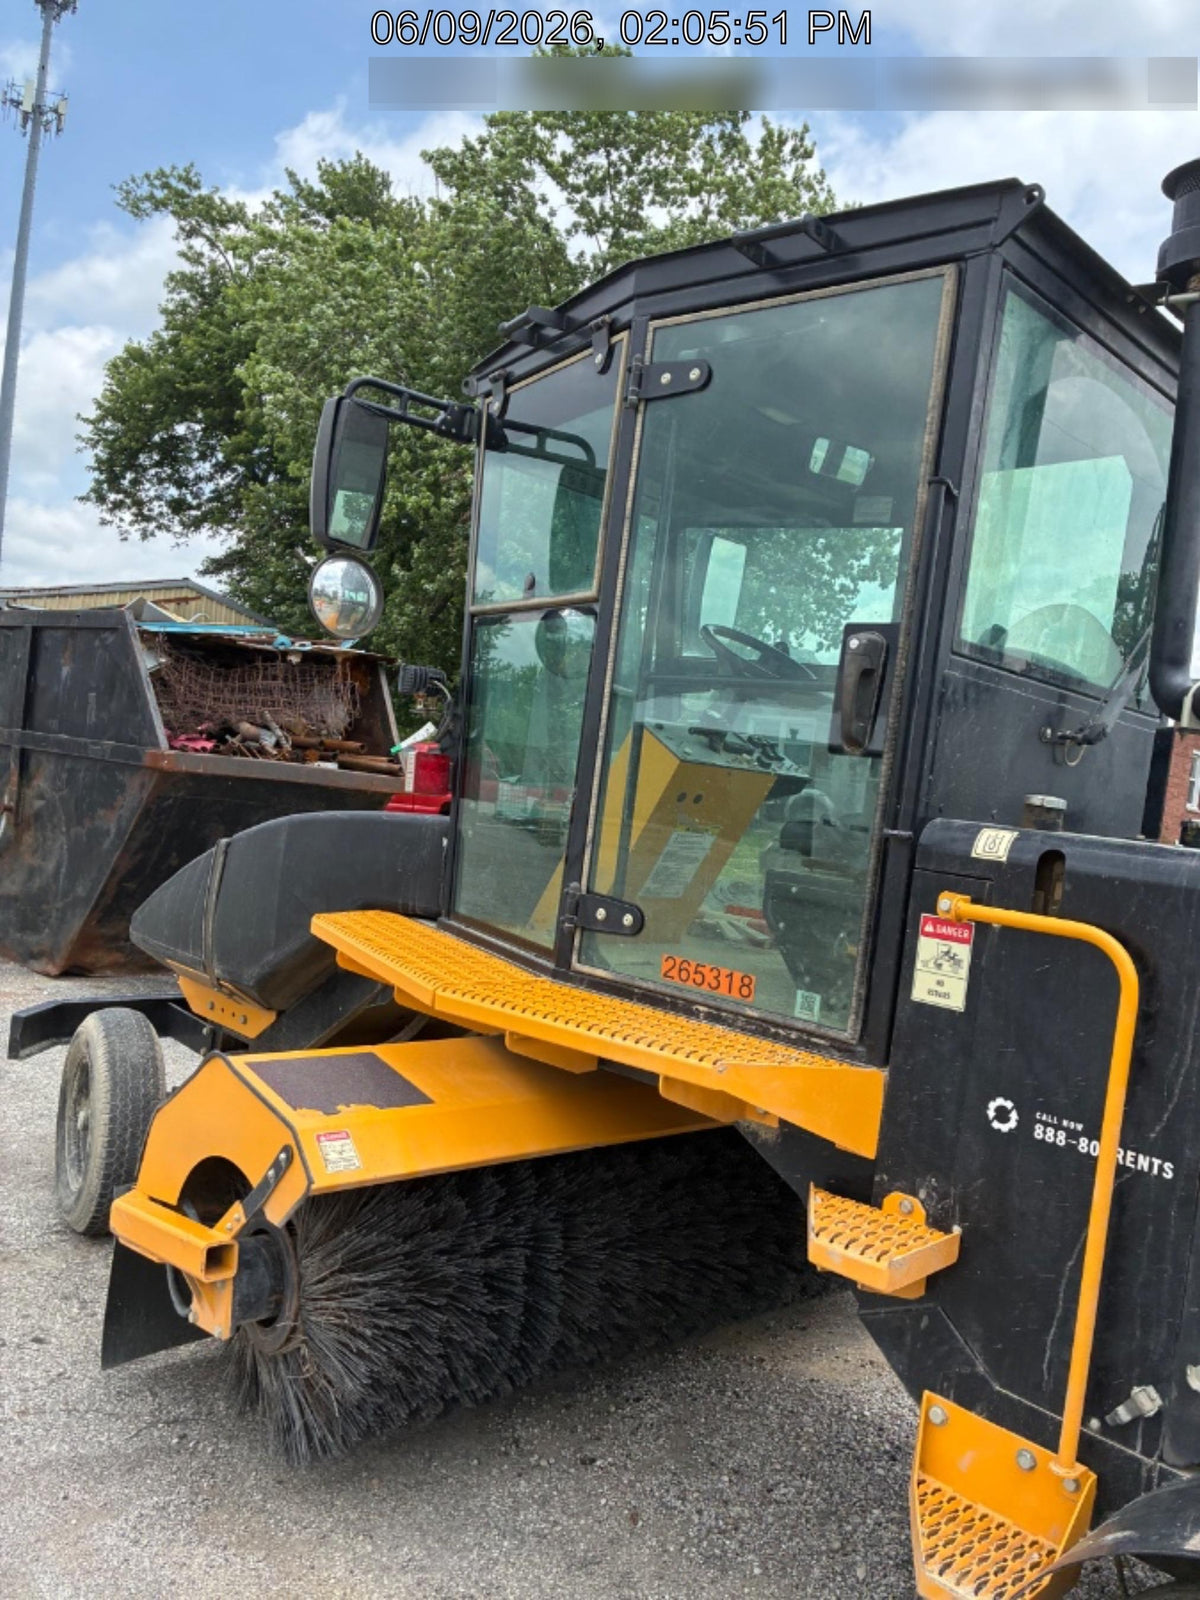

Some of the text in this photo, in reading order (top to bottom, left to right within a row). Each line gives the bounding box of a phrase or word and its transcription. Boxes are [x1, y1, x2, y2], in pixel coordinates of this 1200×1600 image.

[935, 924, 970, 938] DANGER
[662, 955, 754, 998] 265318
[1035, 1111, 1084, 1132] CALL NOW
